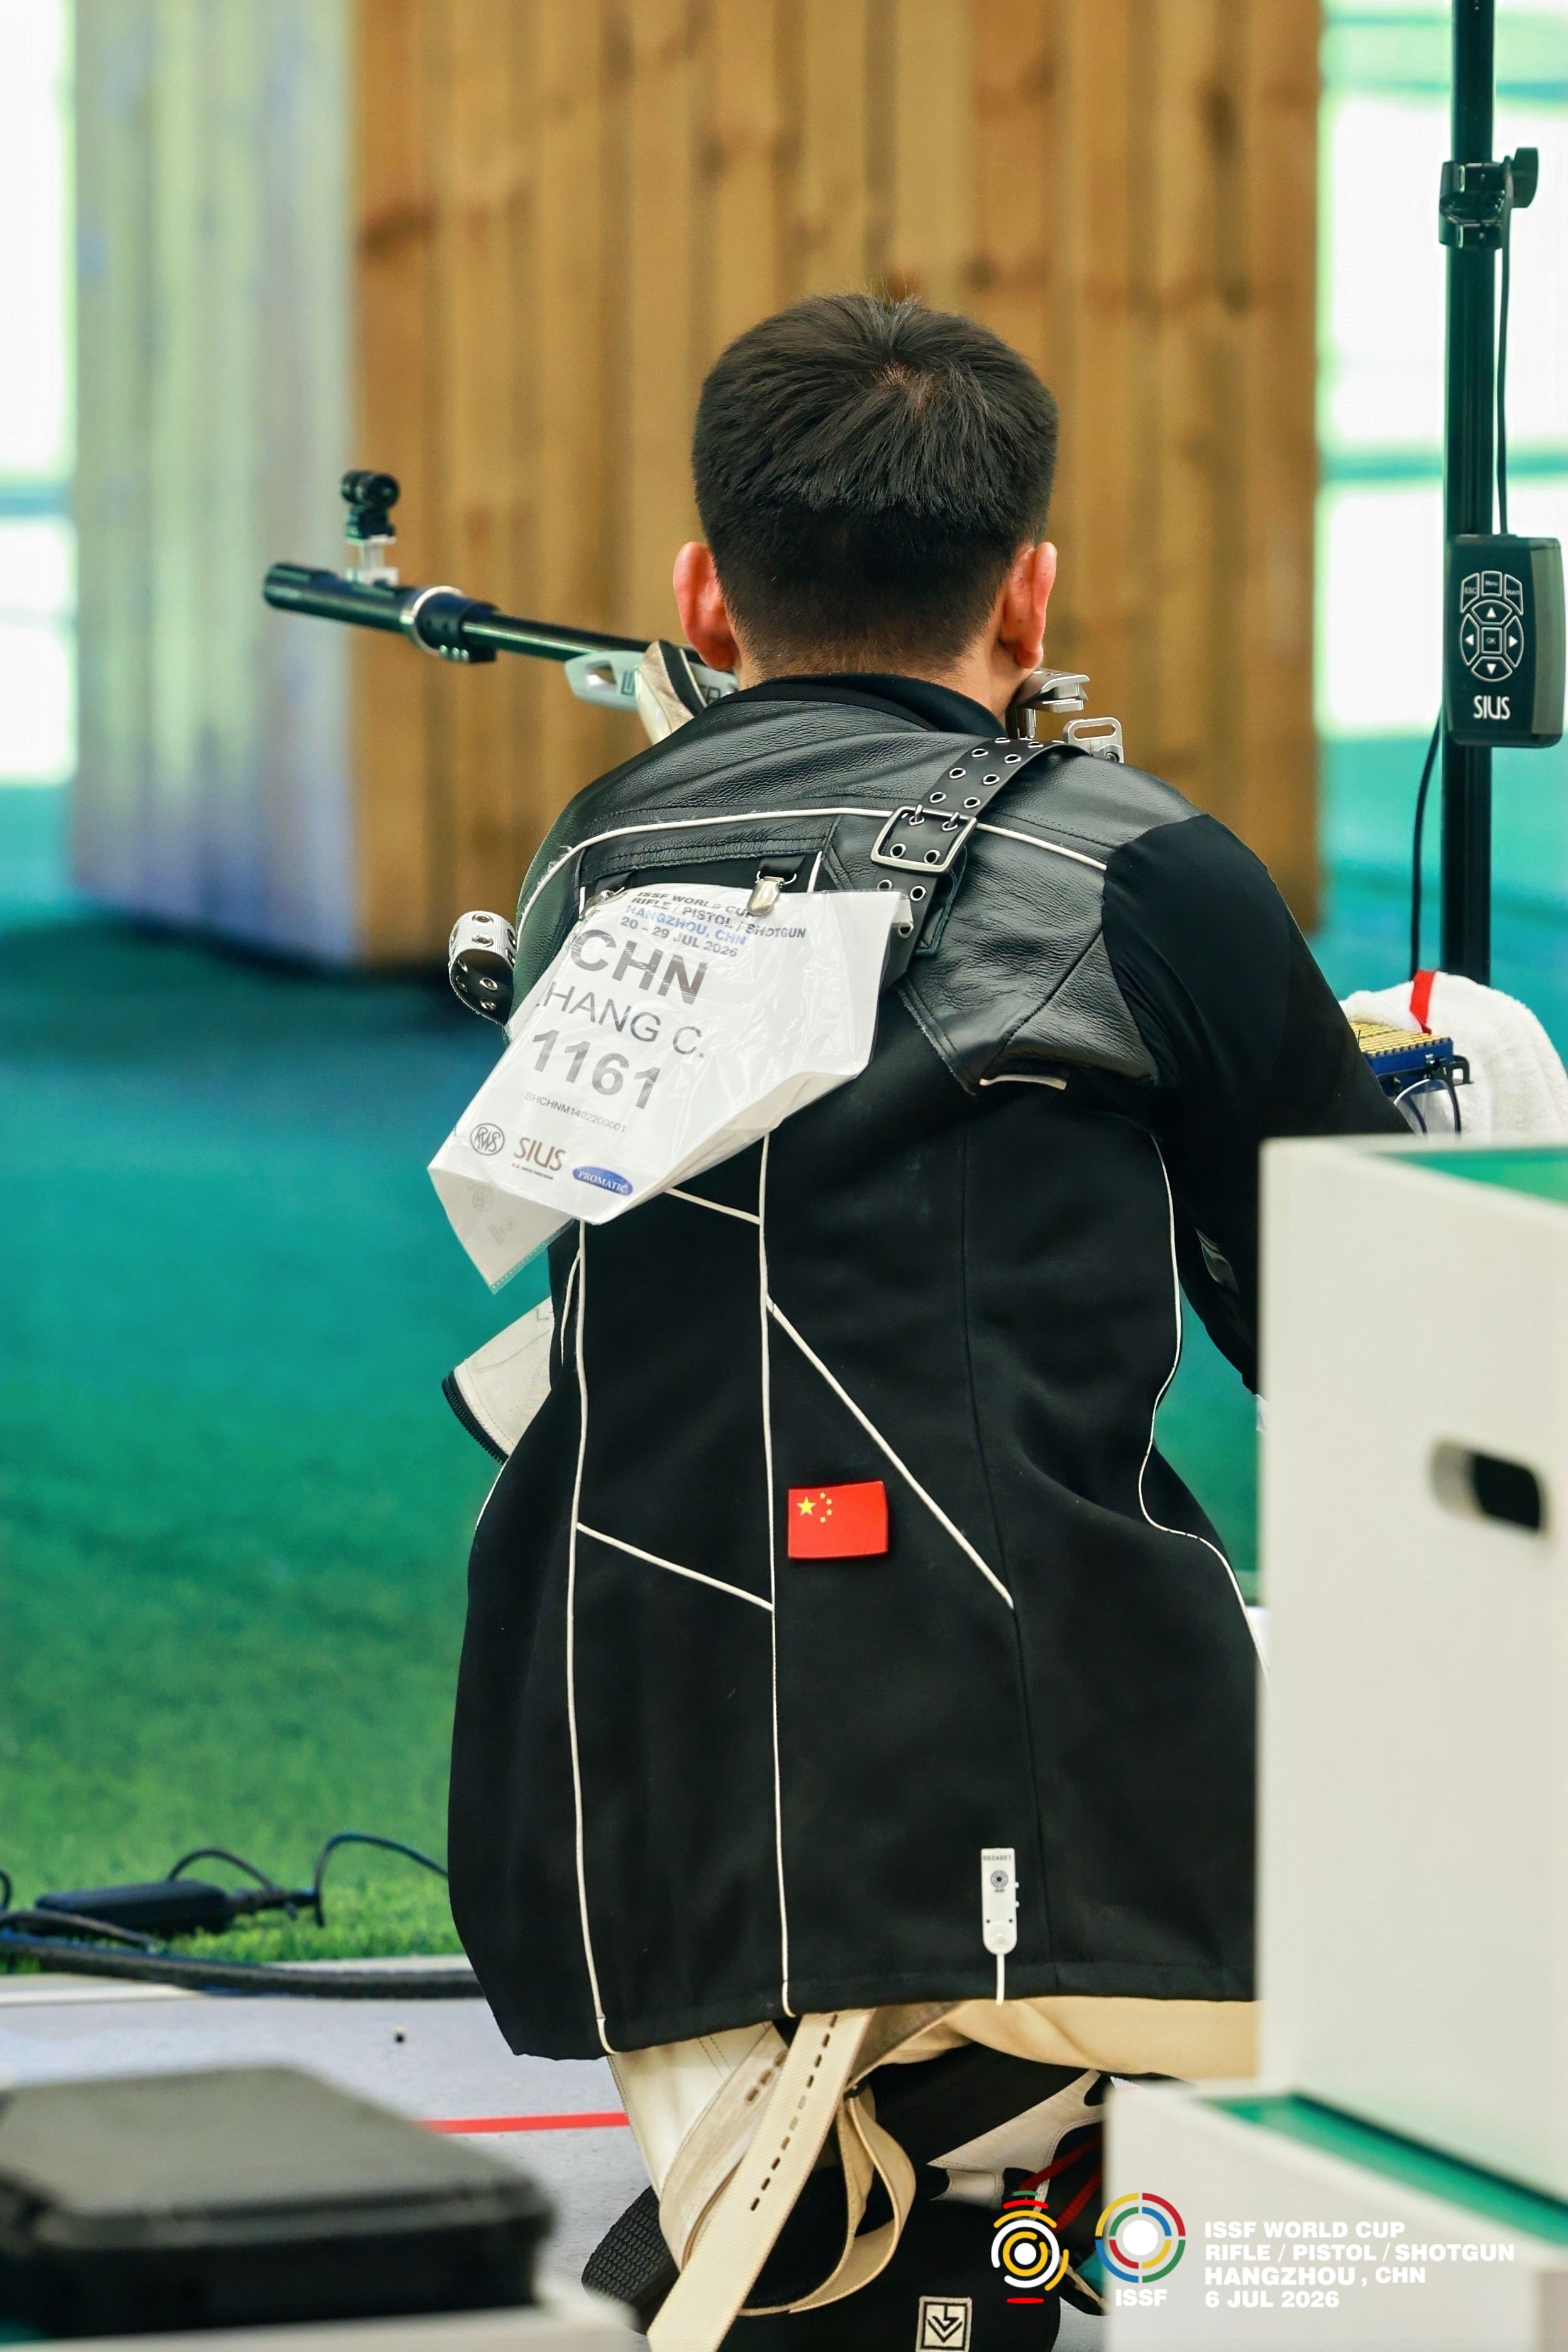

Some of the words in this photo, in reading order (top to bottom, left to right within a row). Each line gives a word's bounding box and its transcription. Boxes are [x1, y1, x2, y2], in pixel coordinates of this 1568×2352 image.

[1473, 695, 1511, 720] SIUS
[631, 897, 671, 910] RIFLE
[682, 907, 732, 929] PISTOL
[746, 924, 807, 938] SHOTGUN
[637, 892, 671, 900] ISSF
[672, 895, 722, 910] WORLD
[620, 916, 639, 930] 20
[651, 925, 670, 939] 29
[672, 932, 698, 950] JUL
[703, 941, 737, 957] 2026
[714, 929, 747, 946] CHN
[570, 929, 708, 1005] CHN
[536, 981, 661, 1042] HANG
[672, 1025, 705, 1058] C.
[533, 1029, 661, 1109] 1161
[514, 1137, 566, 1171] SIUS
[578, 1170, 629, 1195] PROMATIC
